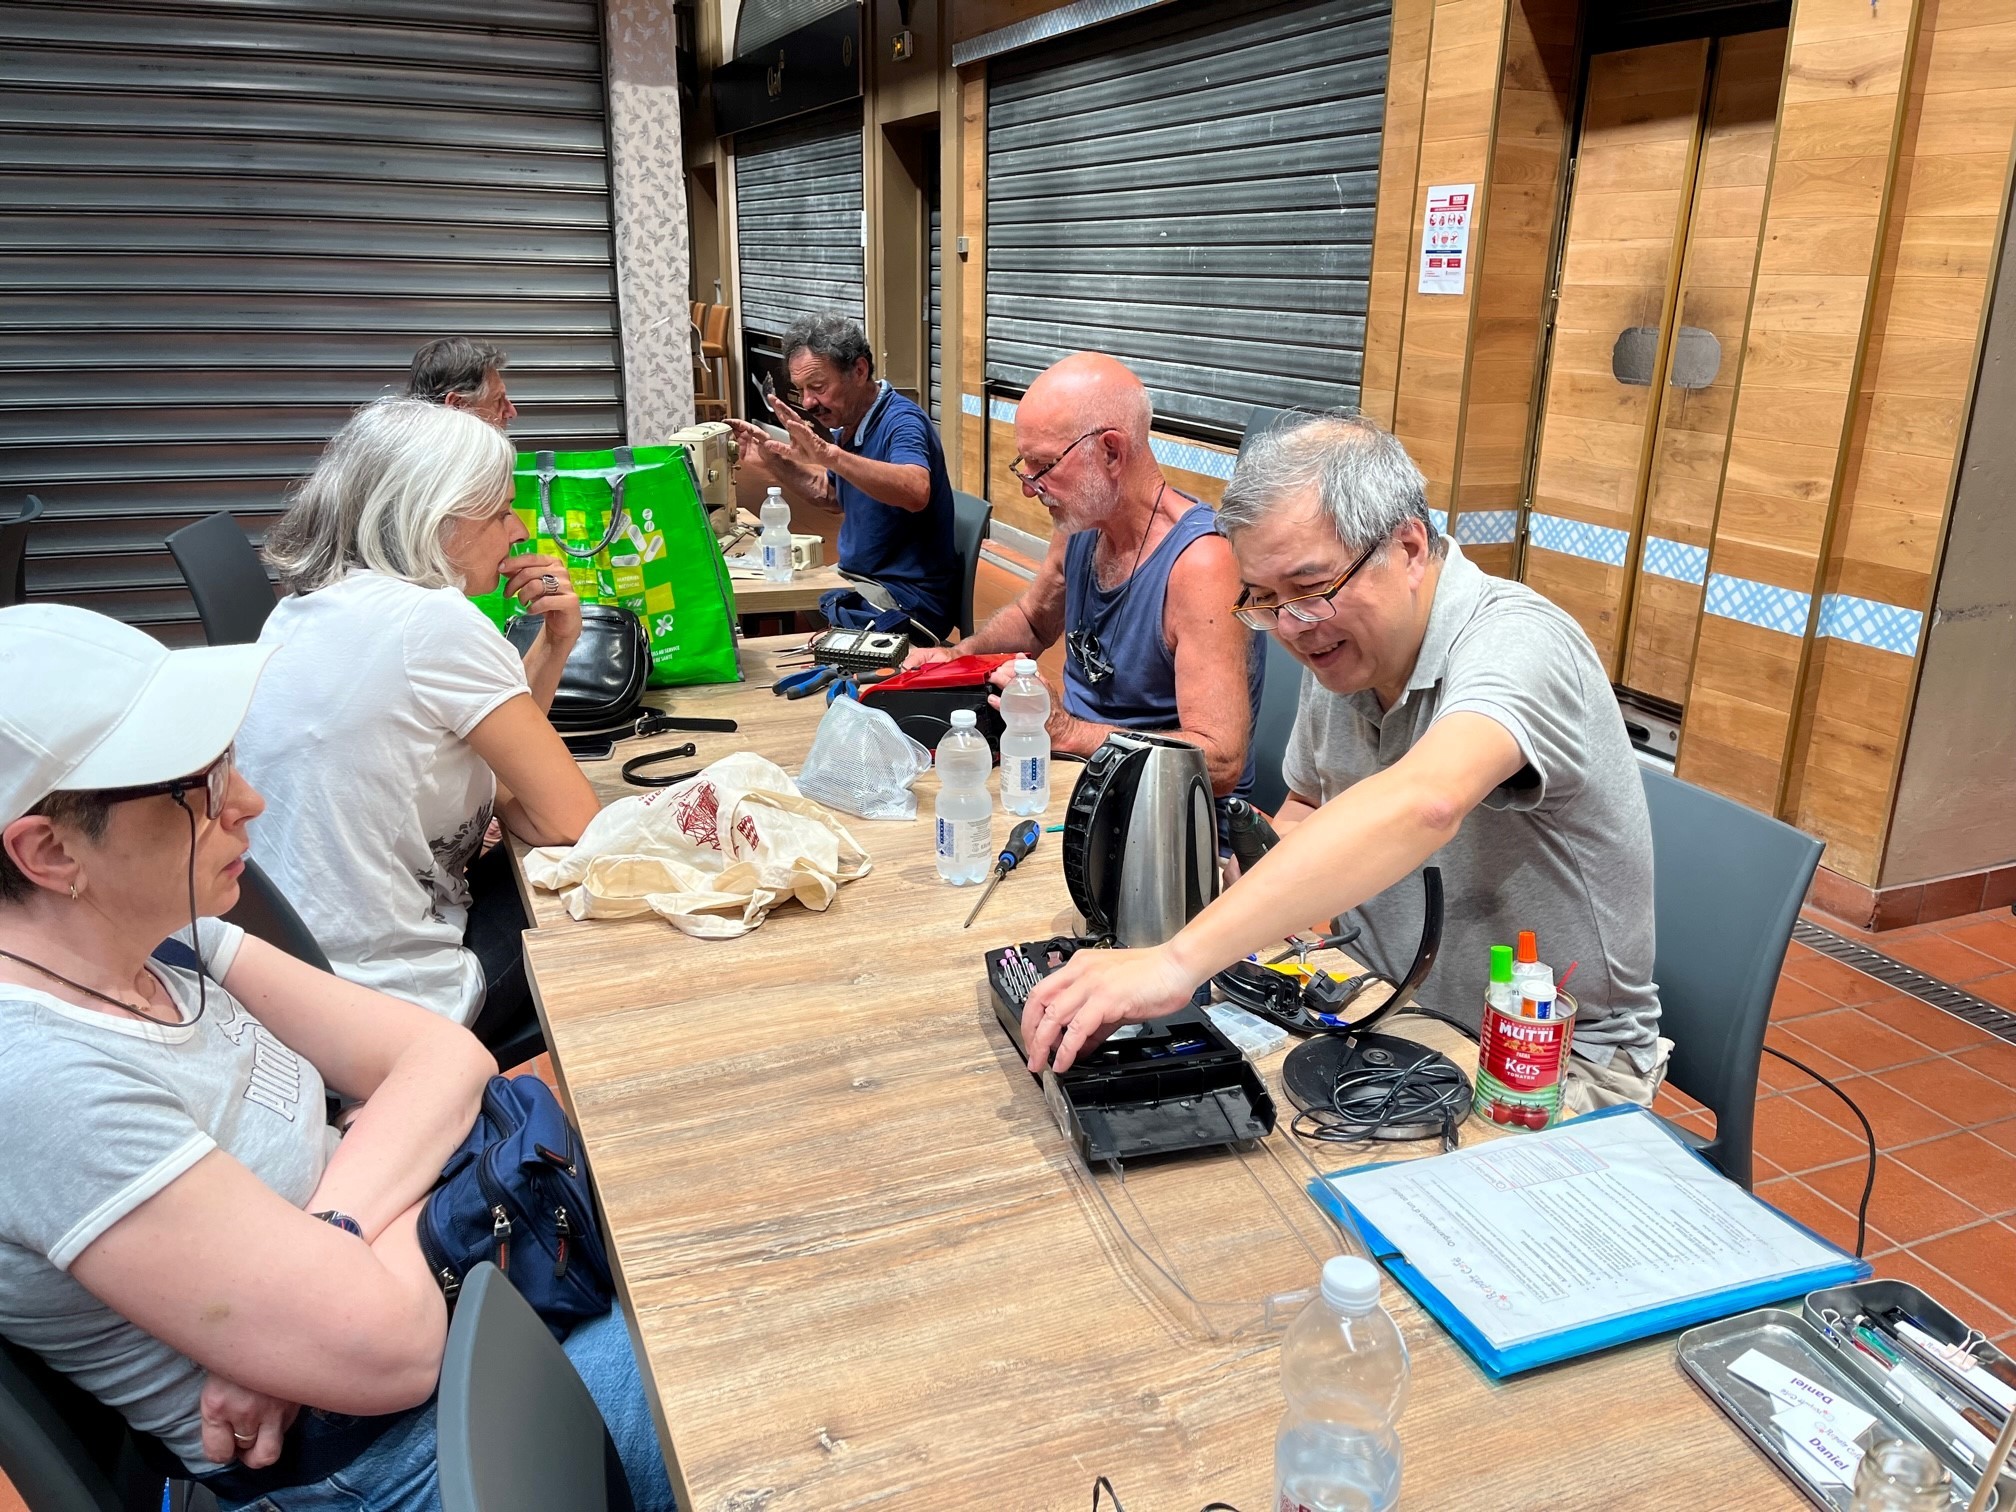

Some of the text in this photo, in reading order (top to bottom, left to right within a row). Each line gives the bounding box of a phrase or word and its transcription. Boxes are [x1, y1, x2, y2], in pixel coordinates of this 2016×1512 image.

[1499, 1021, 1554, 1043] MUTTI
[1505, 1057, 1540, 1076] Kers
[1420, 1211, 1455, 1248] Organisation
[1451, 1256, 1498, 1300] Repair Café
[1790, 1377, 1834, 1405] Daniel
[1808, 1437, 1850, 1470] Daniel
